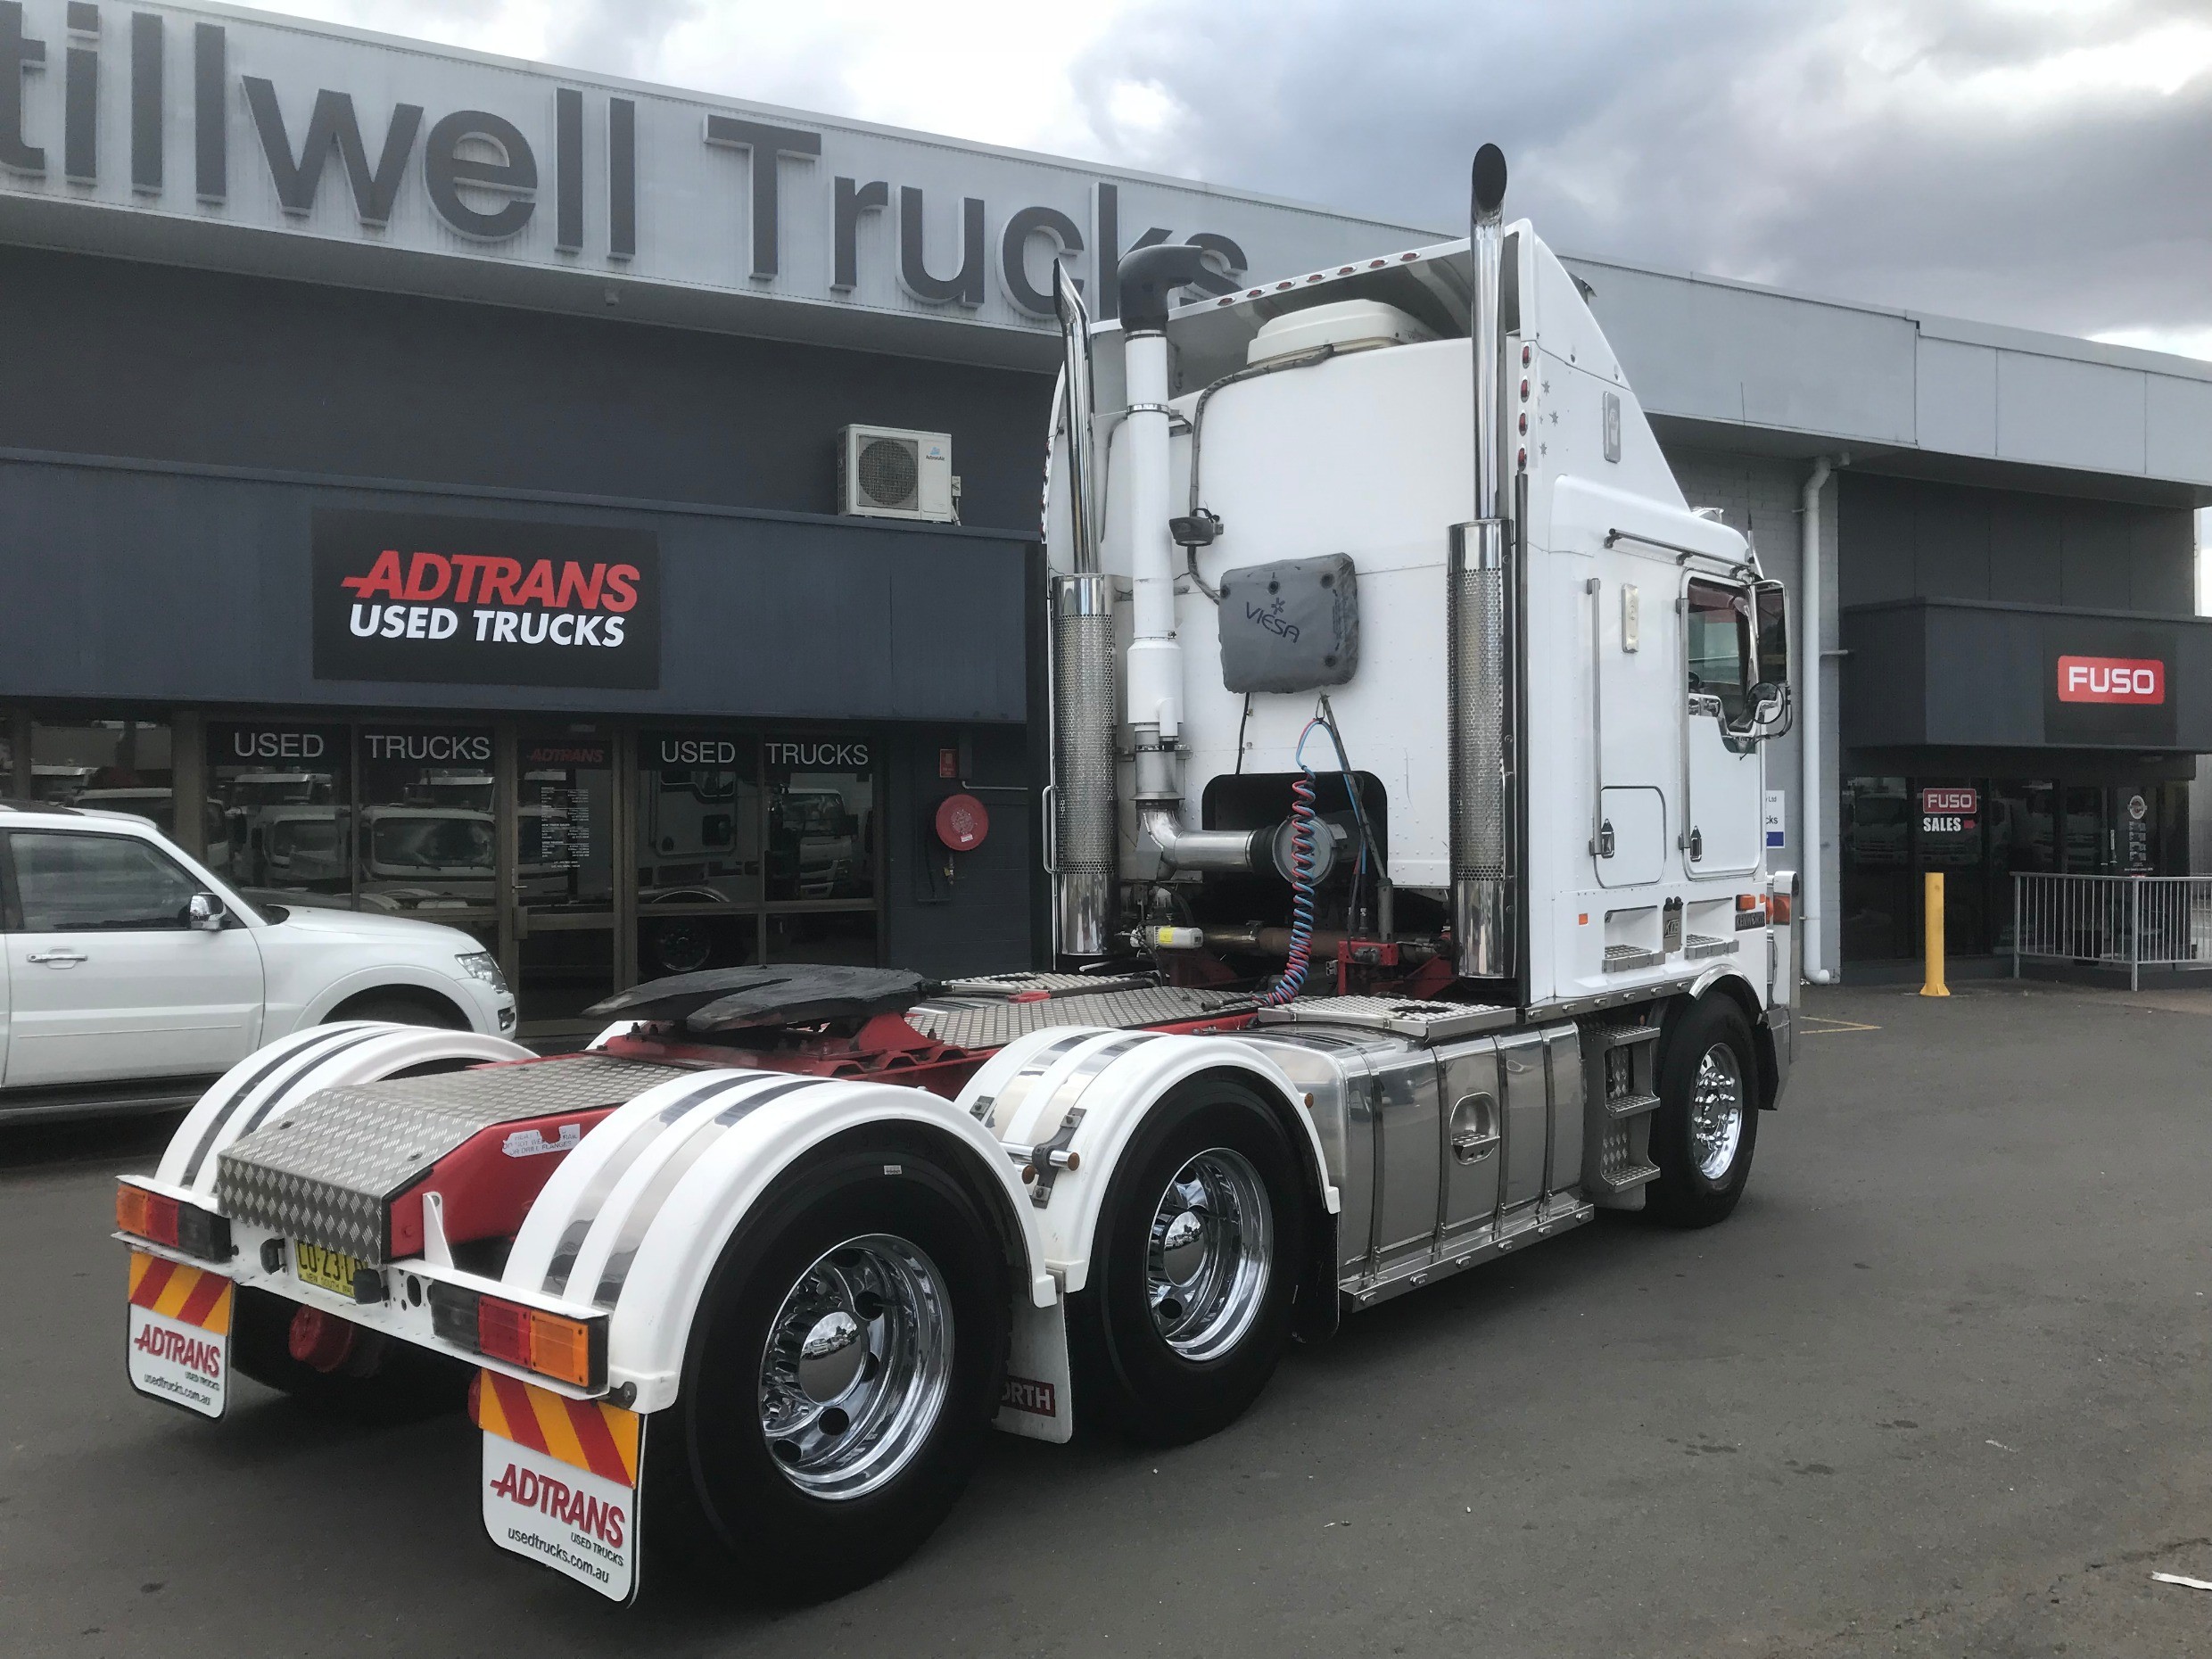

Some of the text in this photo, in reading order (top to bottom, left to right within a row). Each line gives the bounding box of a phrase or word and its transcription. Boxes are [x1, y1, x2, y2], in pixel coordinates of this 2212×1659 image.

[705, 114, 1247, 319] Trucks
[341, 549, 640, 613] ADTRANS
[350, 604, 625, 648] USED TRUCKS
[1245, 601, 1300, 644] VIESA
[2068, 666, 2155, 694] FUSO
[233, 731, 491, 761] USED TRUCKS
[661, 740, 869, 766] USED TRUCKS
[1927, 793, 1972, 808] FUSO
[1923, 817, 1961, 832] SALES
[134, 1324, 221, 1378] ADTRANS
[490, 1463, 625, 1549] ADTRANS
[508, 1527, 610, 1584] usedtrucks.com.au
[571, 1531, 623, 1567] USED TRUCKS
